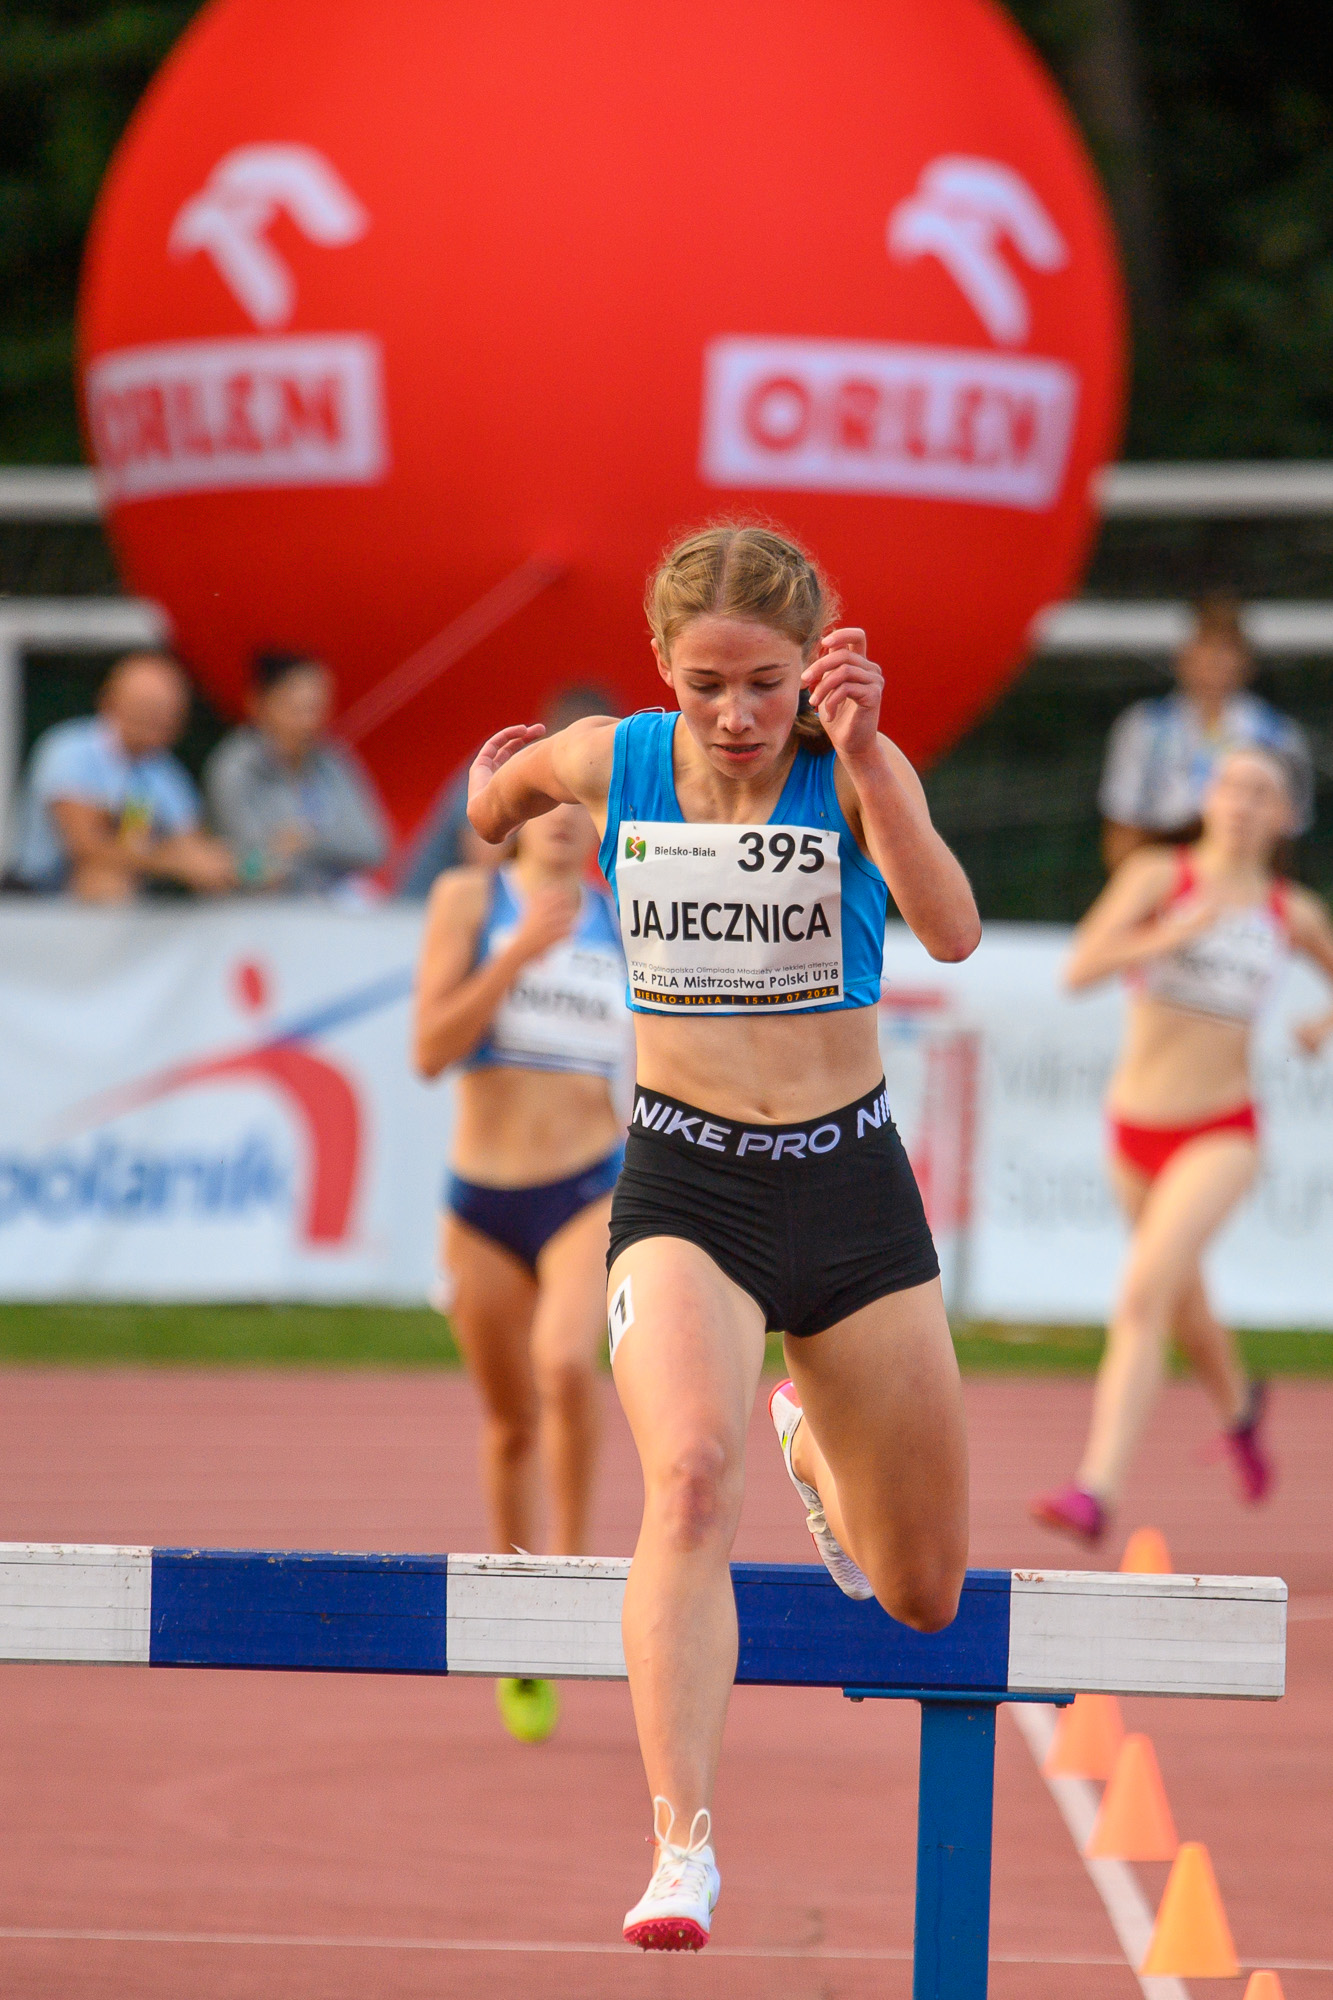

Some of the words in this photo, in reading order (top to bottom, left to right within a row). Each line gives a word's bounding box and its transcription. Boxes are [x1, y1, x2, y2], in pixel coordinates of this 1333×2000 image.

[740, 372, 1046, 468] ORLEN
[654, 846, 716, 857] Bielsko-Biała
[737, 832, 825, 873] 395
[630, 899, 832, 943] JAJECZNICA
[632, 970, 648, 984] 54.
[651, 973, 679, 989] PZLA
[684, 975, 765, 989] Mistrzostwa
[769, 971, 808, 988] Polski
[813, 968, 839, 982] U18
[696, 966, 735, 975] Olimpiada
[807, 960, 839, 969] atletyce
[636, 989, 722, 1005] BIELSKO-BIAŁA
[744, 987, 836, 1005] 15-17.07.2022
[632, 1095, 732, 1153] NIKE
[735, 1123, 842, 1161] PRO
